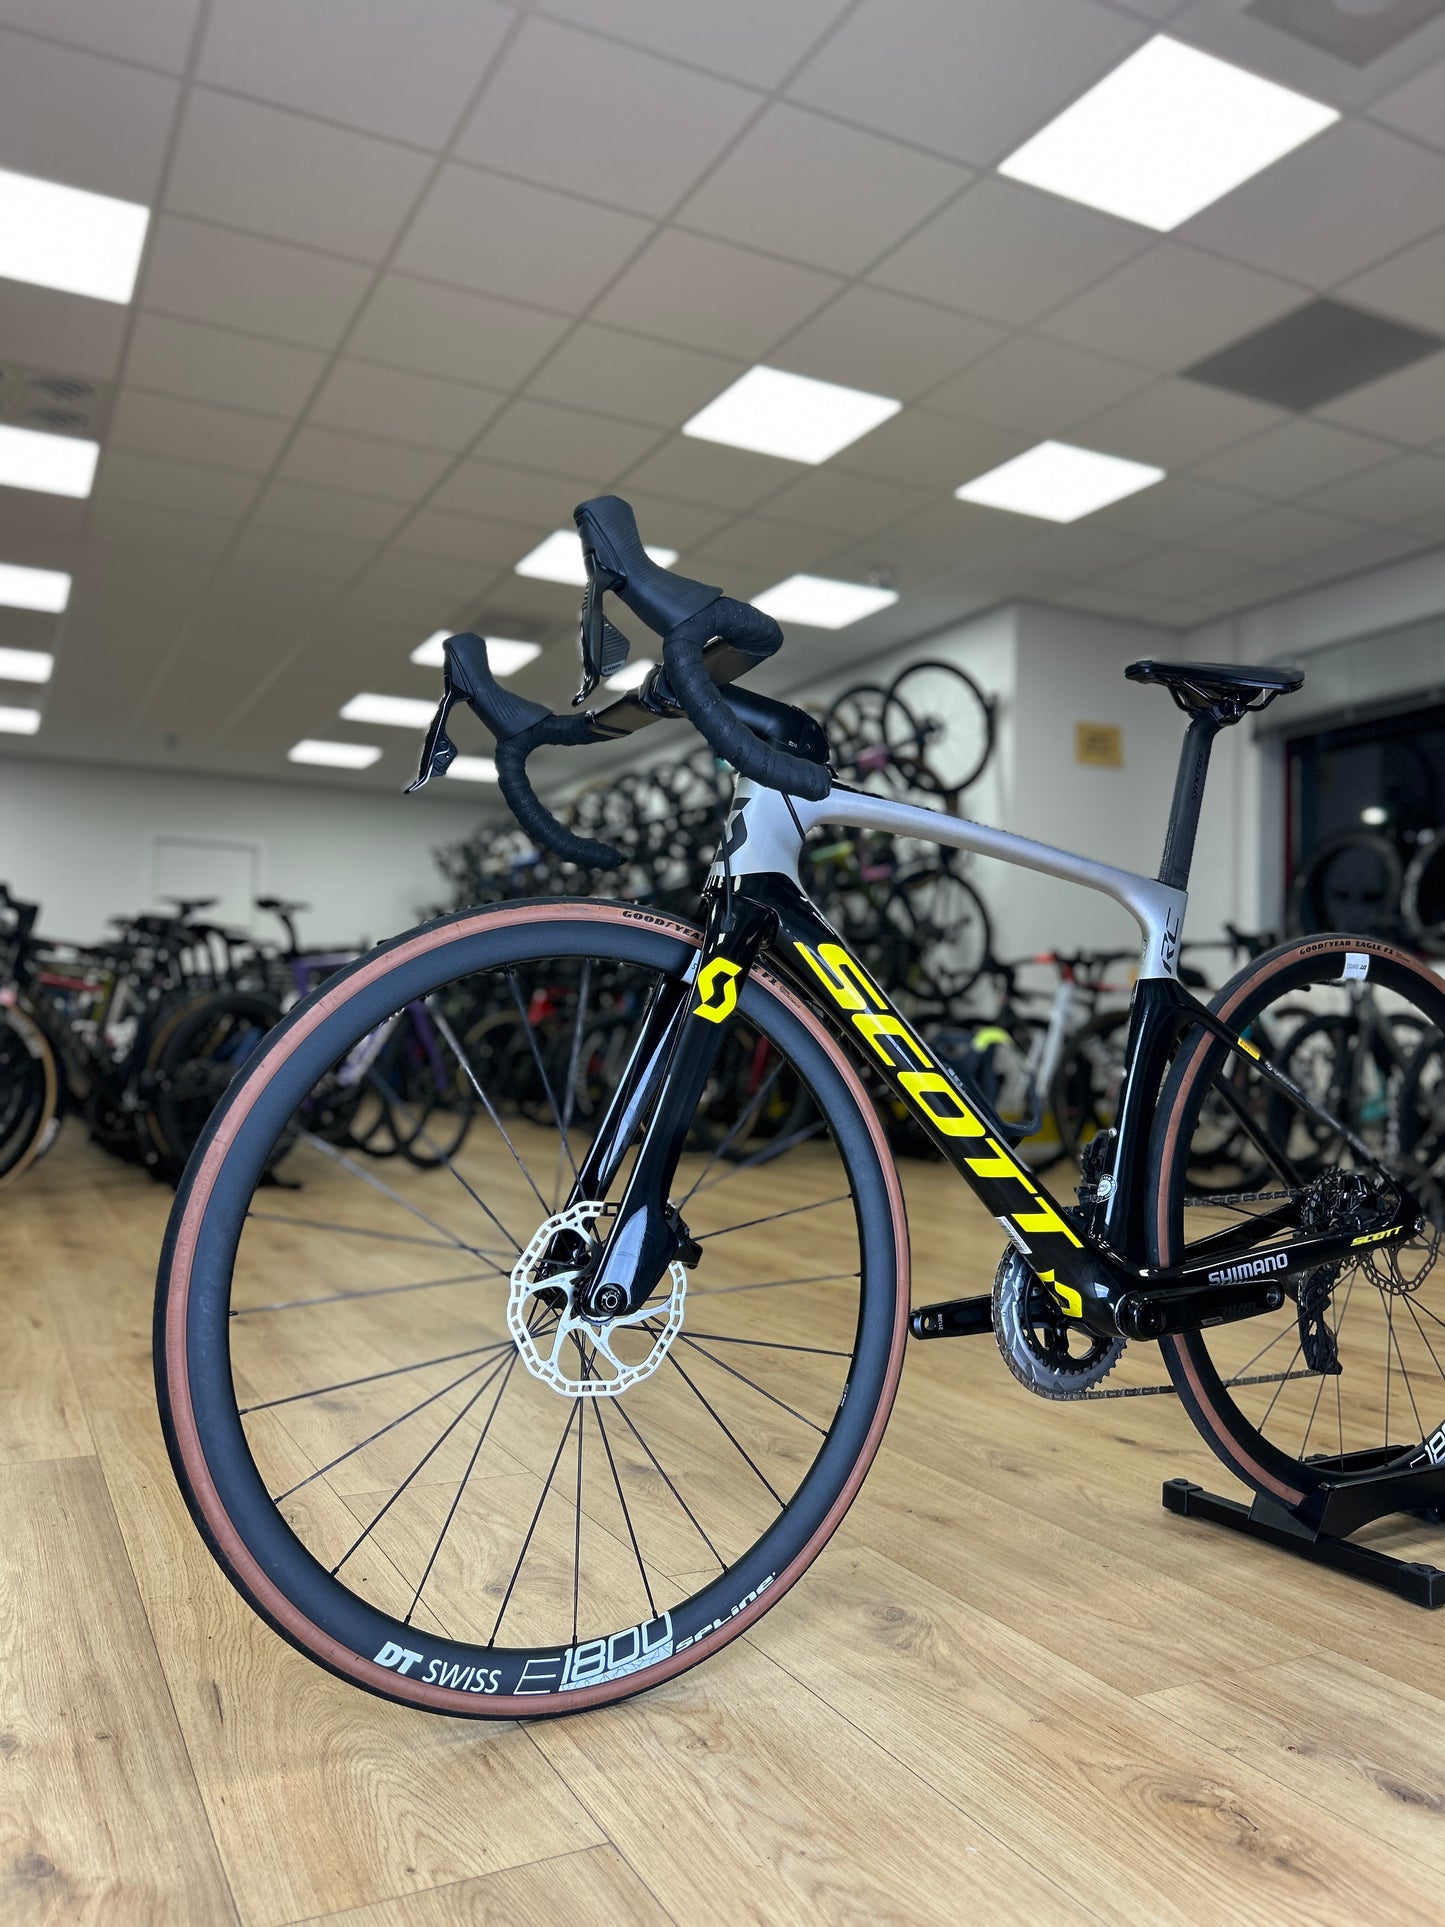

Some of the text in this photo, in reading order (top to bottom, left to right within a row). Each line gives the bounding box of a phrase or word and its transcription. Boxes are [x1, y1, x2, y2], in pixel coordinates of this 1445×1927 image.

[1300, 940, 1351, 955] GOODYEAR
[1355, 941, 1381, 952] EAGLE
[793, 941, 1083, 1248] SCOTT
[1350, 1225, 1403, 1247] SCOTT
[1208, 1253, 1288, 1285] SHIMANO
[373, 1640, 423, 1674] DT
[422, 1658, 502, 1694] SWISS
